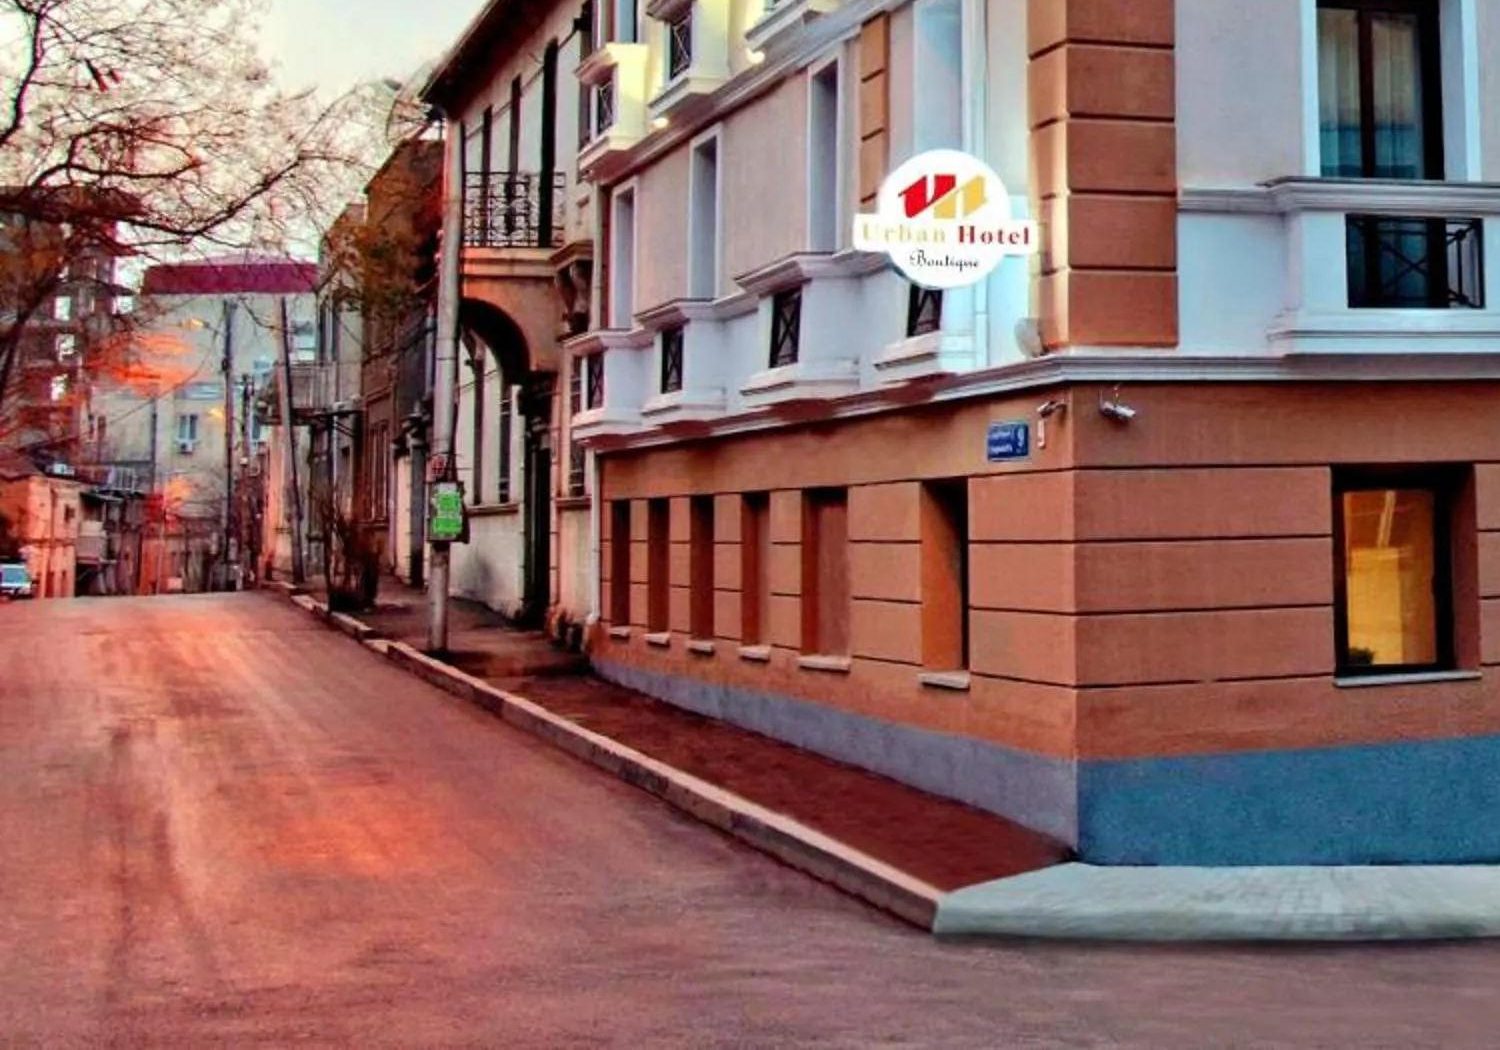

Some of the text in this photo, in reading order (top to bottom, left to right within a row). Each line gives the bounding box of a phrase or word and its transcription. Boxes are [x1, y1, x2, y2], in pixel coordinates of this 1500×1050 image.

[862, 222, 1030, 245] Urban Hotel
[909, 249, 979, 272] Boutique
